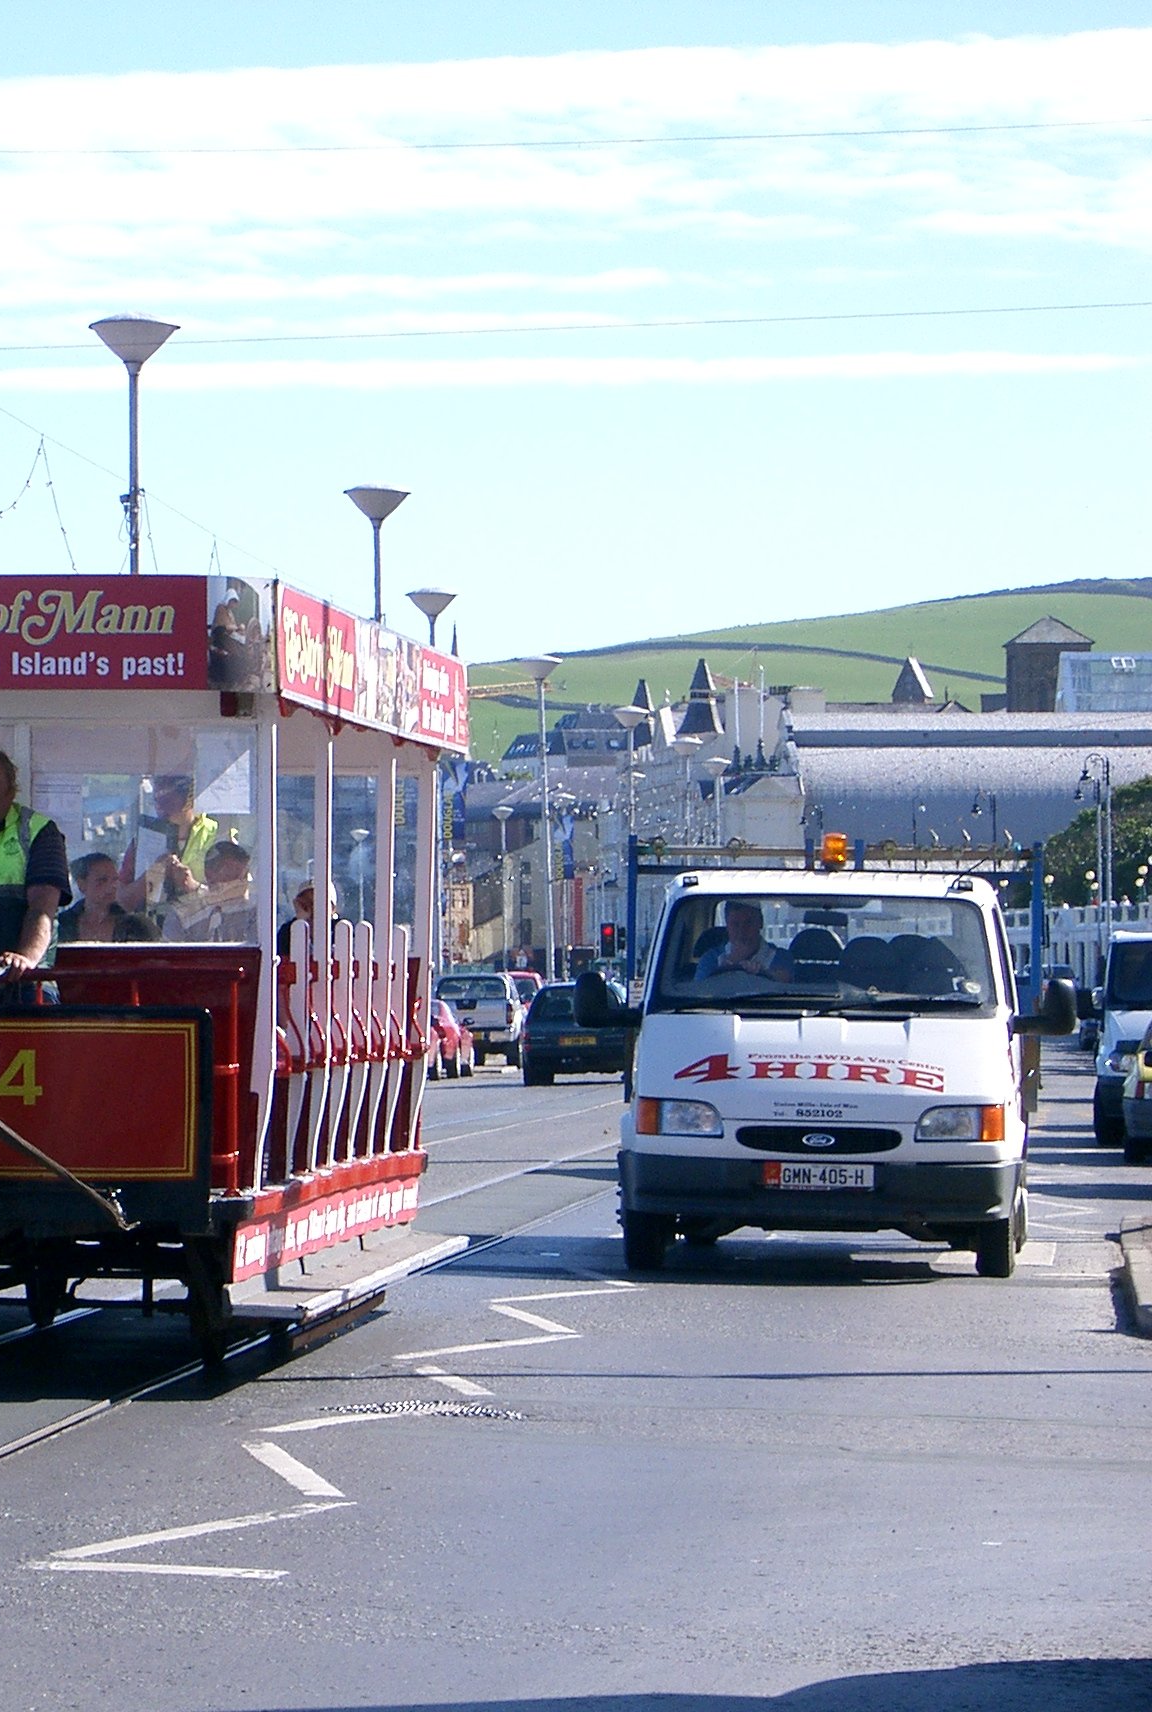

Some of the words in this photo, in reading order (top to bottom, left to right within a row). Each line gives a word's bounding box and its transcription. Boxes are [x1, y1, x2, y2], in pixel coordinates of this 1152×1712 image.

[21, 590, 175, 646] Mann
[11, 652, 110, 676] Island's
[122, 652, 185, 681] past!
[867, 1056, 895, 1065] Van
[674, 1053, 741, 1084] 4
[747, 1061, 945, 1093] HIRE
[795, 1108, 843, 1118] 852102
[782, 1167, 865, 1184] GMN-405-H
